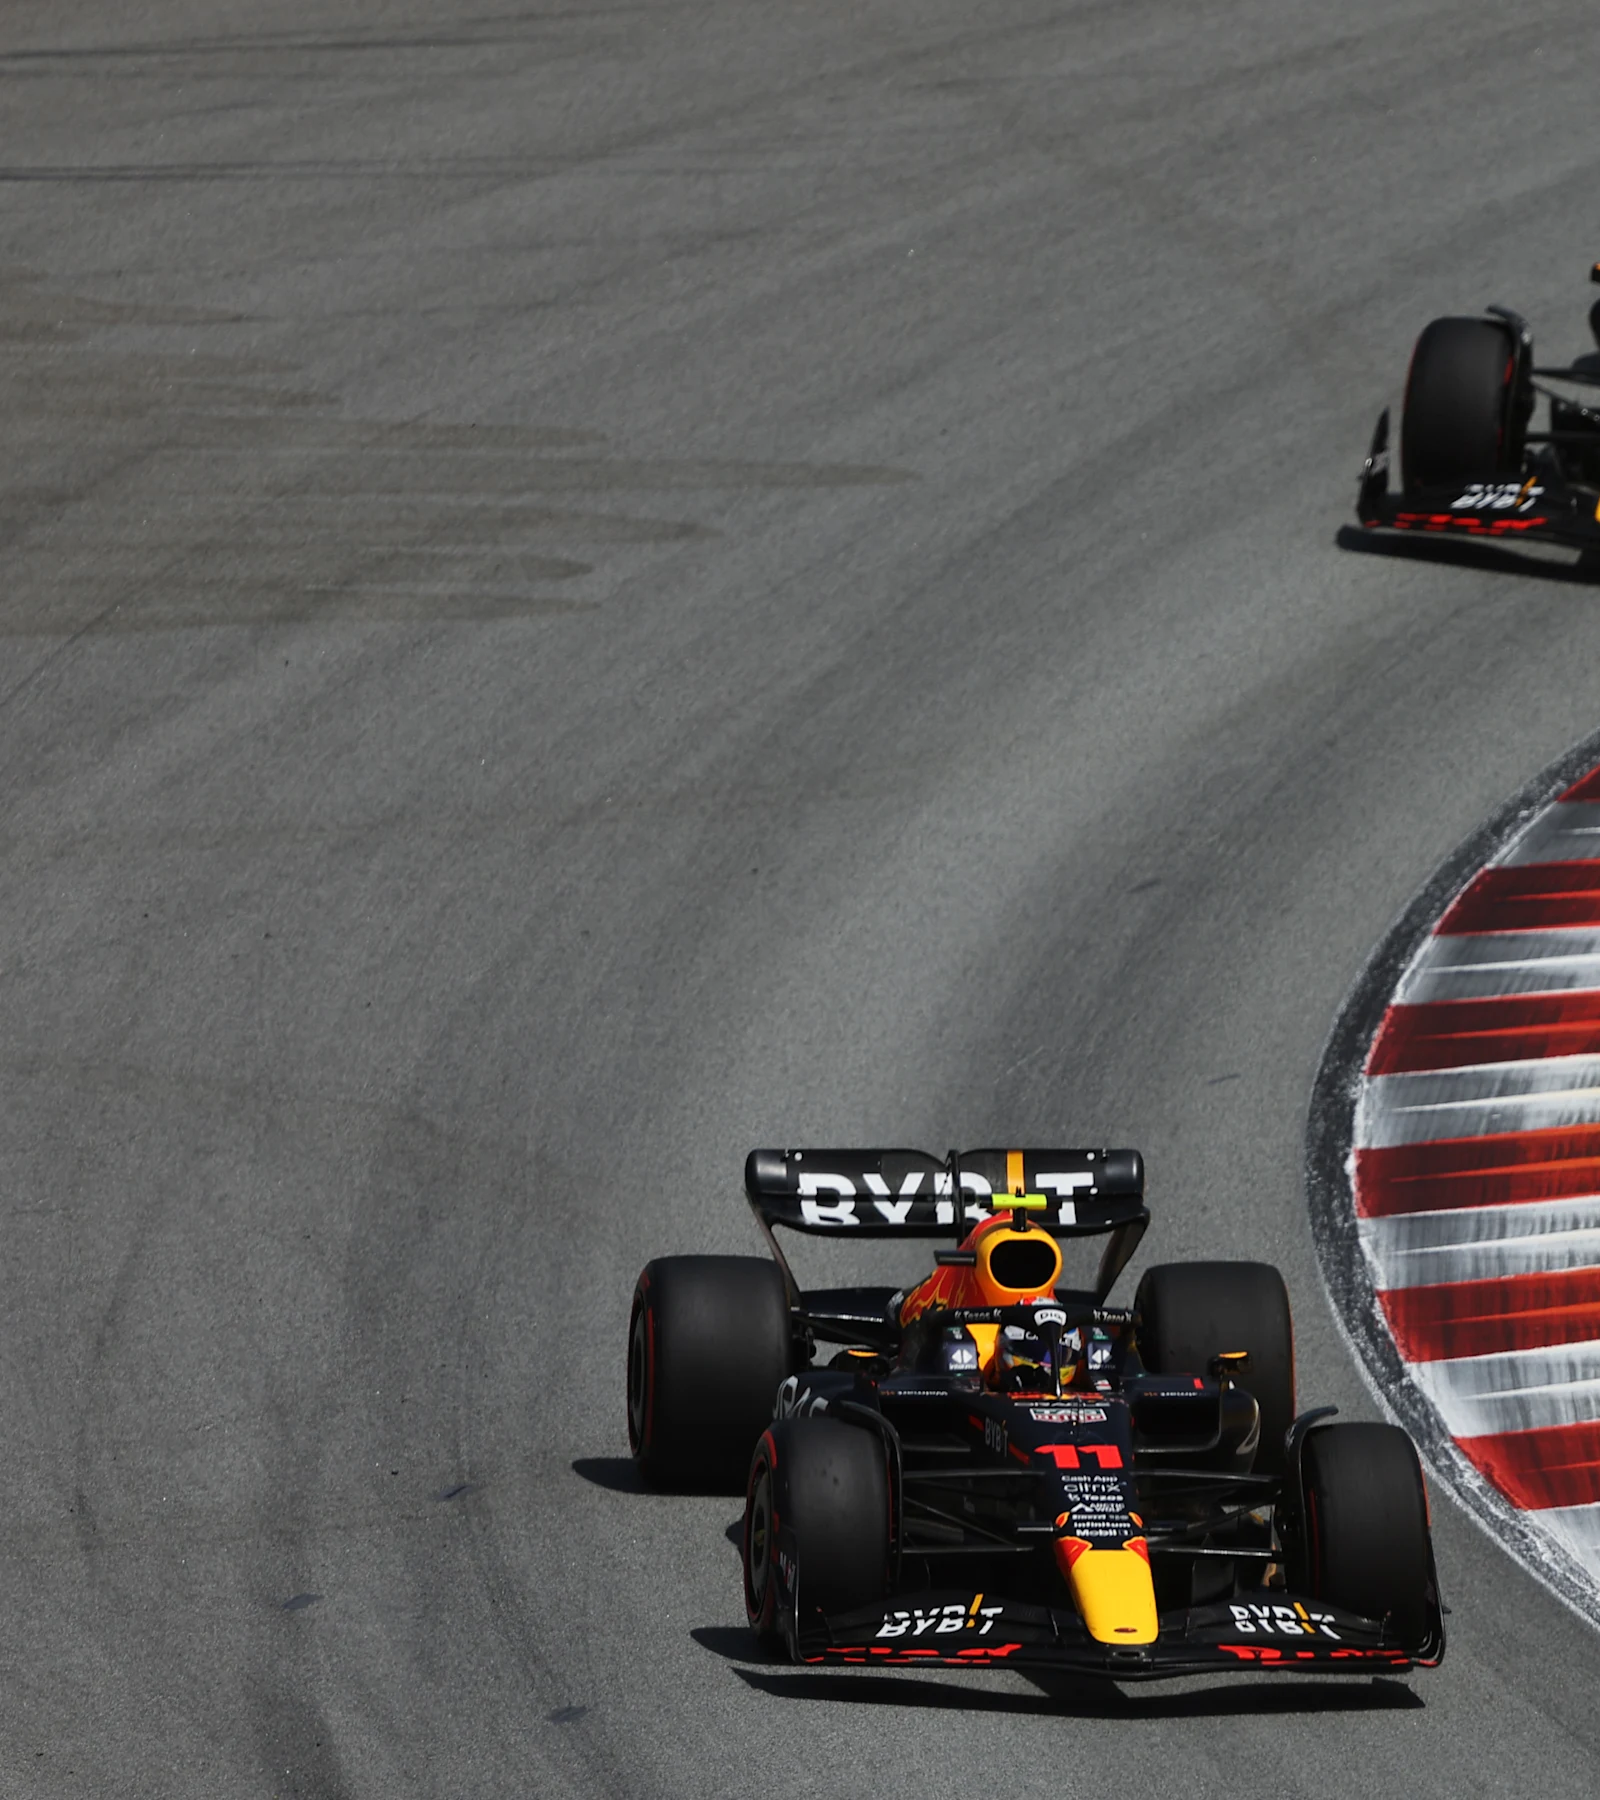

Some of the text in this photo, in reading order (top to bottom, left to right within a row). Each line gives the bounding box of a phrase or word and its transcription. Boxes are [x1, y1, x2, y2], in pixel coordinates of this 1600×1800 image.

[1034, 1444, 1123, 1468] 11
[1094, 1475, 1118, 1483] App
[875, 1593, 1004, 1637] BYBIT
[1229, 1602, 1342, 1640] BYBIT
